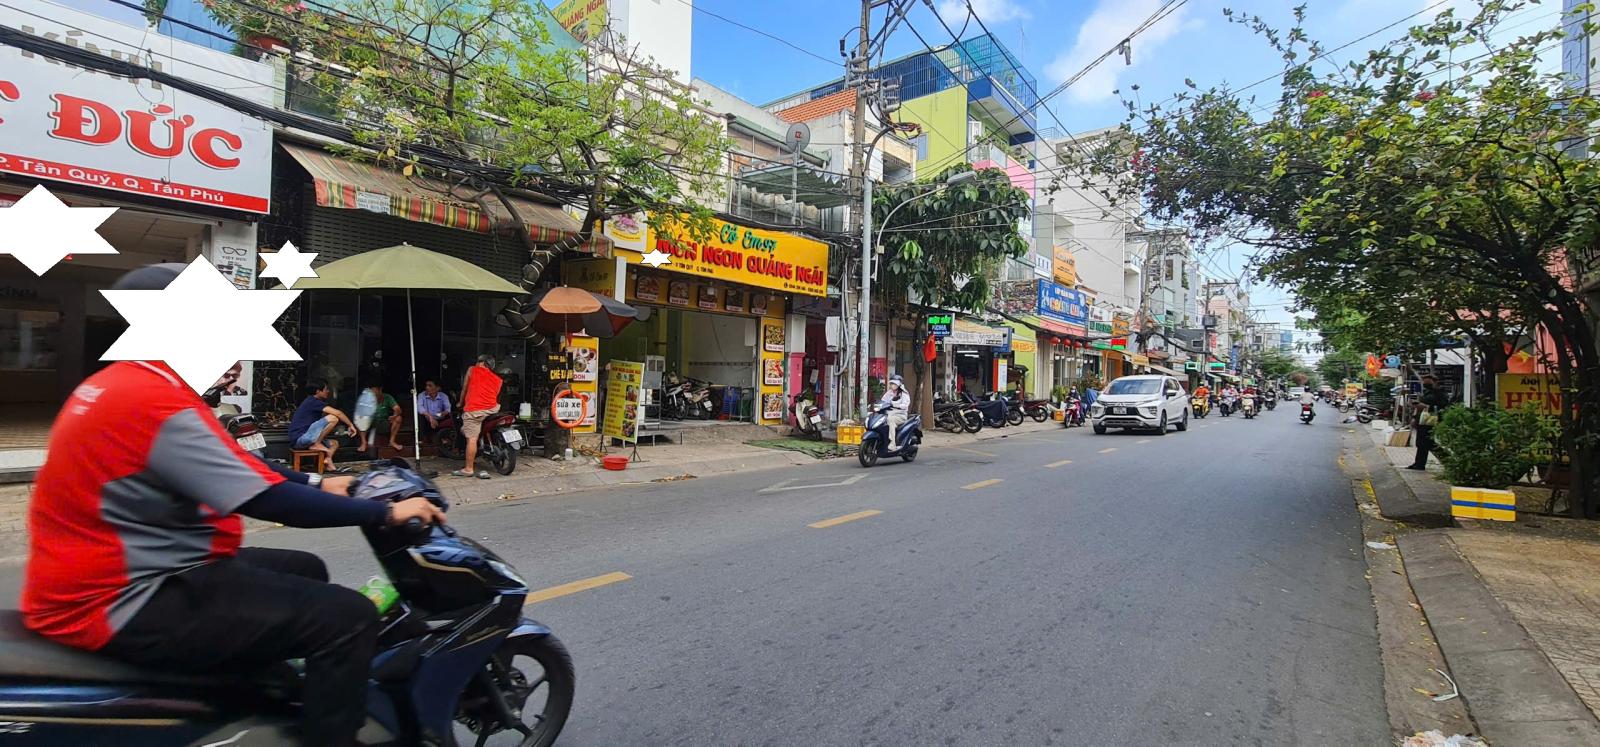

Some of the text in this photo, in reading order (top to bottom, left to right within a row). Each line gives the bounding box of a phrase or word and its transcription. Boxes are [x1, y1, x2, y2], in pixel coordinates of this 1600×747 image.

[50, 93, 243, 169] ĐỨC
[19, 159, 61, 176] Tân
[68, 168, 117, 186] Quý,
[123, 178, 144, 190] Q.
[190, 189, 224, 203] Phú
[702, 245, 743, 270] NGON
[746, 254, 793, 280] QUẢNG
[795, 265, 824, 287] NGÃI
